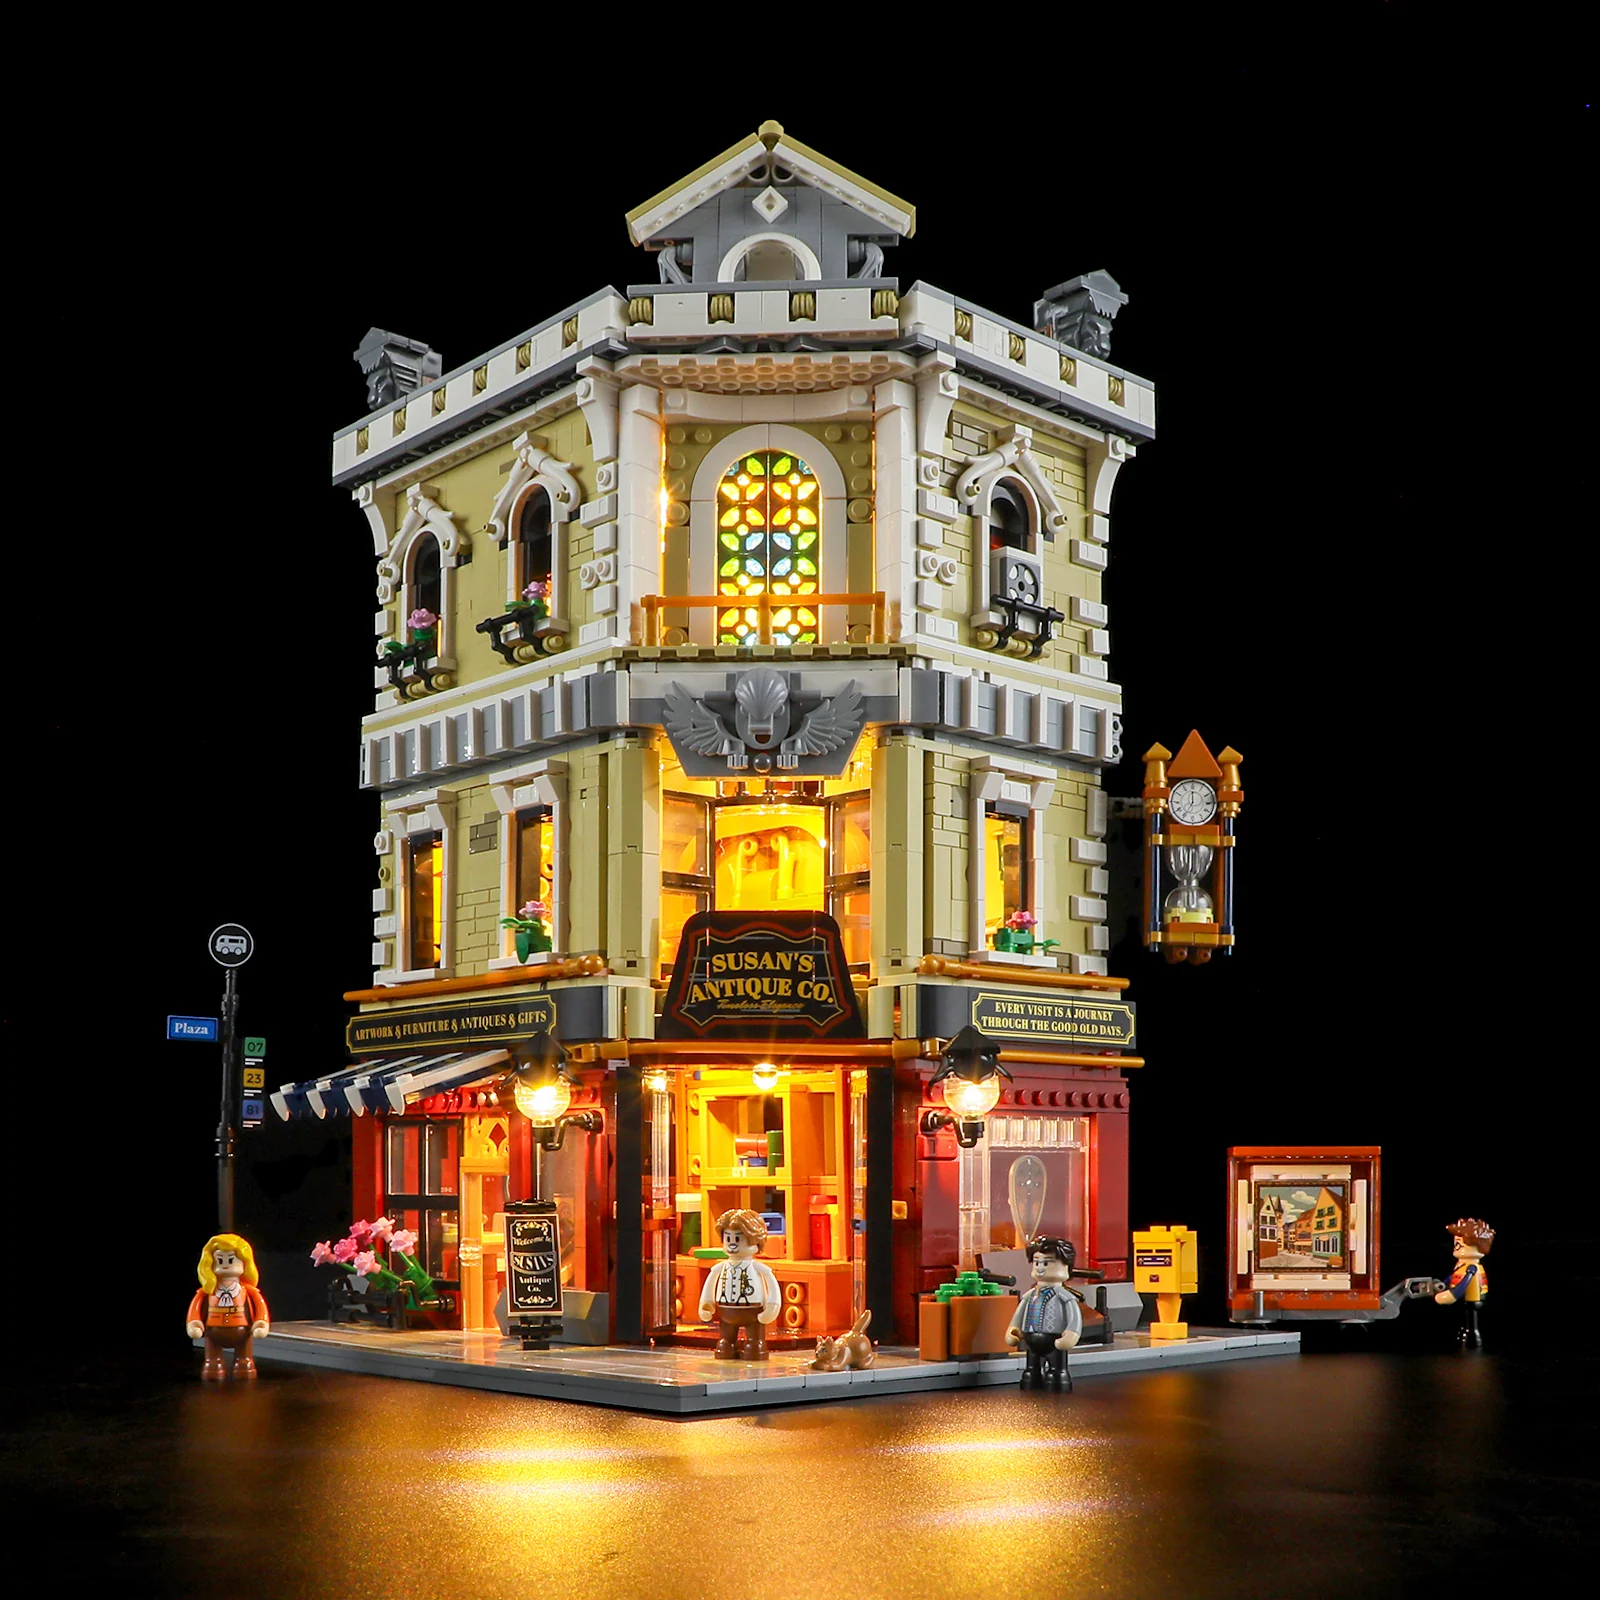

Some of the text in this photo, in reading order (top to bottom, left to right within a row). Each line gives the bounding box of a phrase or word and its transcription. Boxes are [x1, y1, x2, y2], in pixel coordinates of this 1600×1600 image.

[711, 951, 814, 973] SUSAN'S
[690, 978, 834, 1004] ANTIQUE CO.
[717, 999, 805, 1013] Timeless Elegance
[995, 1001, 1114, 1022] EVERY VISIT IS A JOURNEY
[174, 1022, 209, 1035] Plaza
[355, 1009, 547, 1040] ARTWORK & FURNITURE & ANTIQUES & GIFTS
[981, 1016, 1125, 1037] THROUGH THE GOOD OLD DAYS.
[247, 1042, 264, 1052] 07
[247, 1073, 262, 1083] 23
[246, 1104, 259, 1115] 81
[512, 1236, 545, 1246] Welcome
[519, 1276, 552, 1285] Antique
